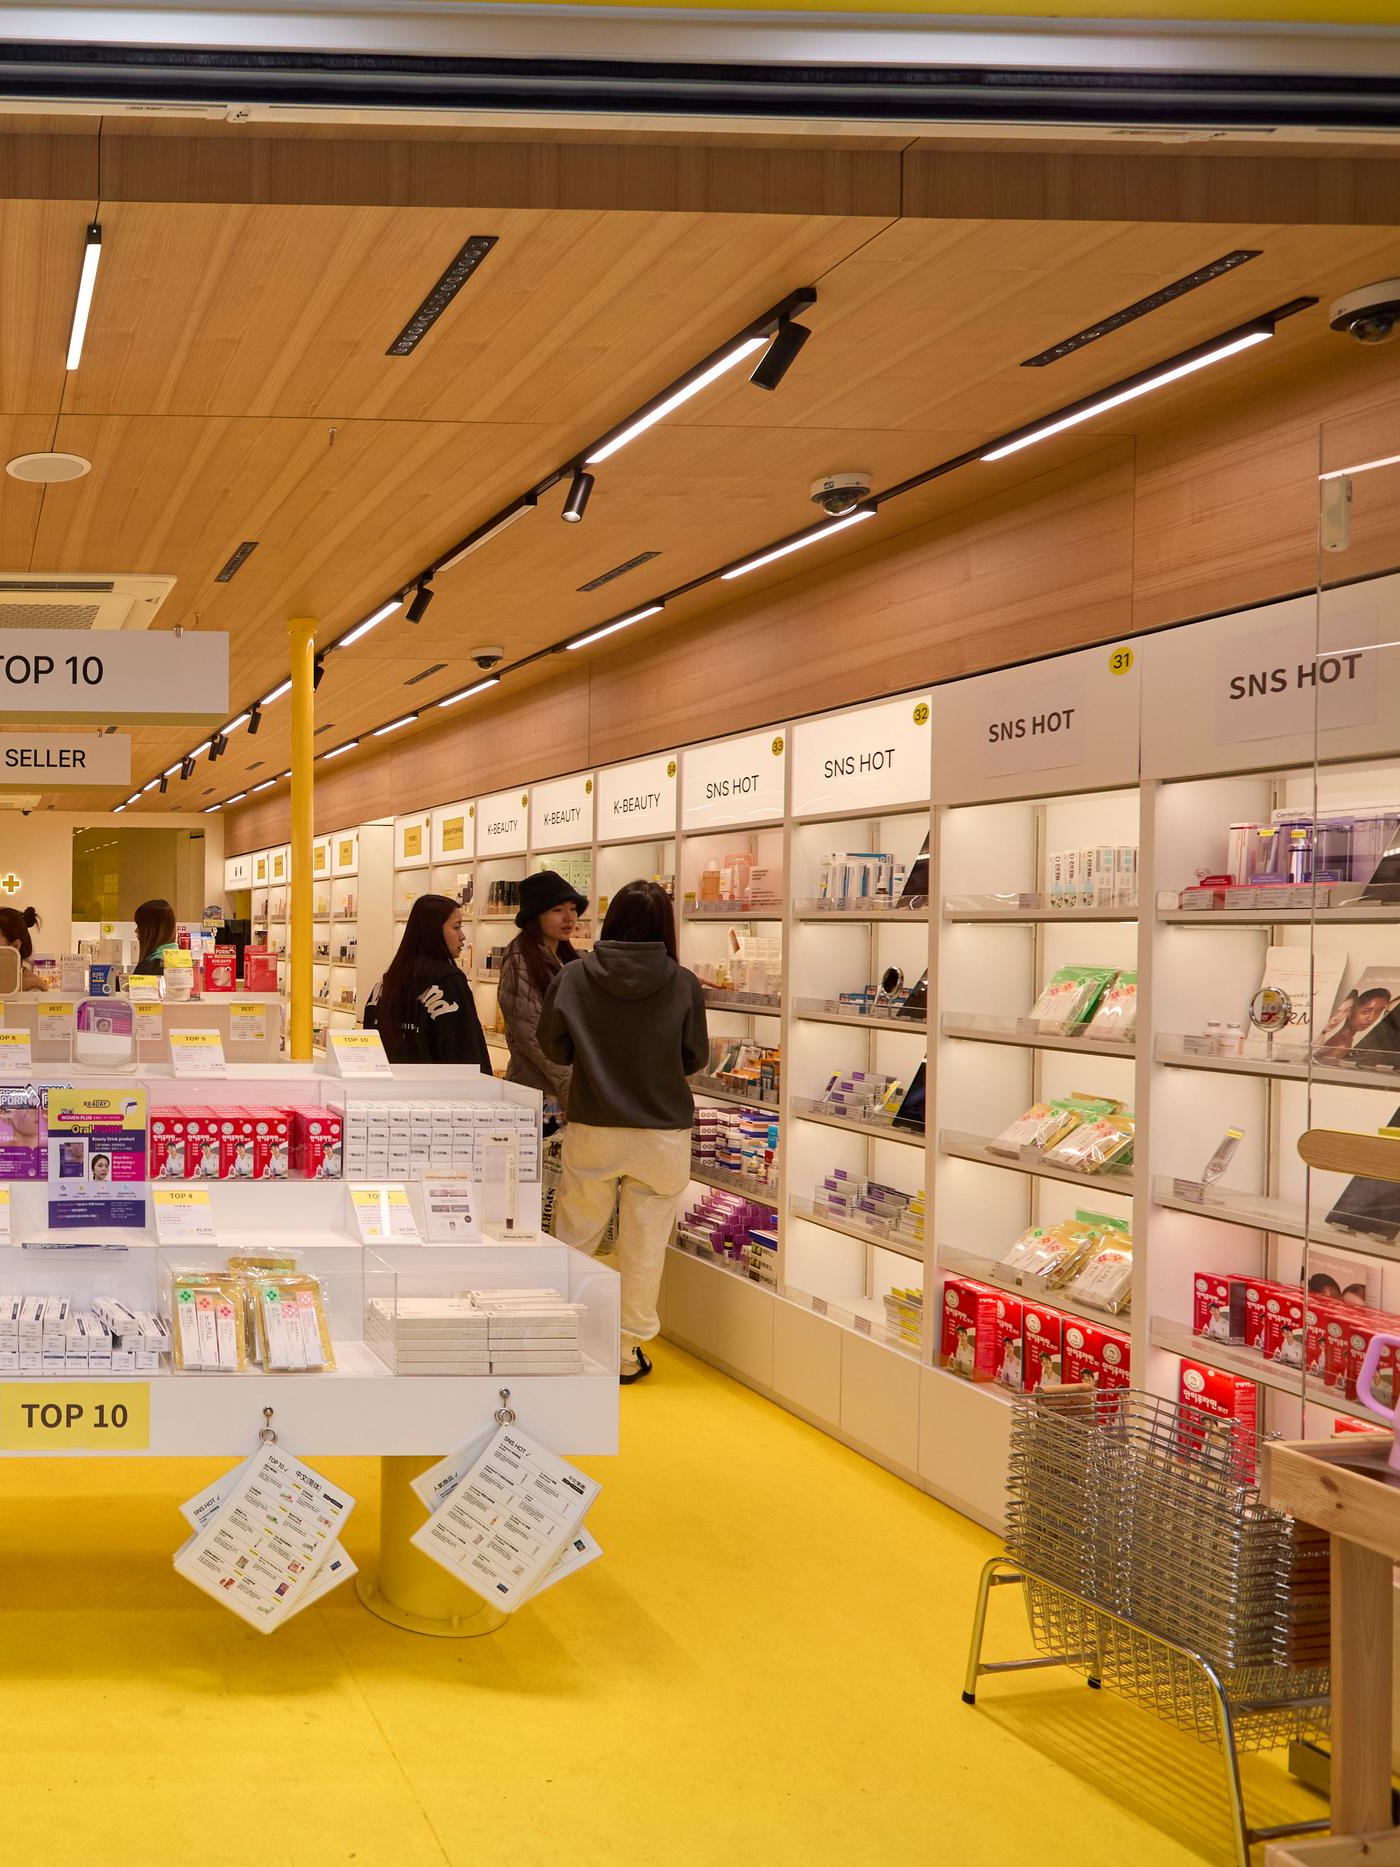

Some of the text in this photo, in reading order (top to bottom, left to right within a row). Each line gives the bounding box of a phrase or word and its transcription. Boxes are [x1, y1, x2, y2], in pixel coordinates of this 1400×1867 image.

[65, 655, 104, 685] 10
[1112, 653, 1130, 669] 31
[1230, 653, 1363, 700] SNS HOT
[913, 707, 928, 721] 32
[988, 709, 1075, 743] SNS HOT
[772, 741, 784, 752] 33
[4, 748, 86, 769] SELLER
[824, 749, 895, 779] SNS HOT
[706, 774, 759, 799] SNS HOT
[613, 793, 661, 815] K-BEAUTY
[544, 807, 581, 826] K-BEAUTY
[487, 819, 518, 836] K-BEAUTY
[1, 1096, 27, 1105] PDRN
[72, 1125, 92, 1134] Oral
[21, 1403, 128, 1428] TOP 10
[503, 1435, 526, 1455] SNS HOT
[267, 1455, 278, 1465] TOP
[194, 1497, 216, 1516] SNS HOT
